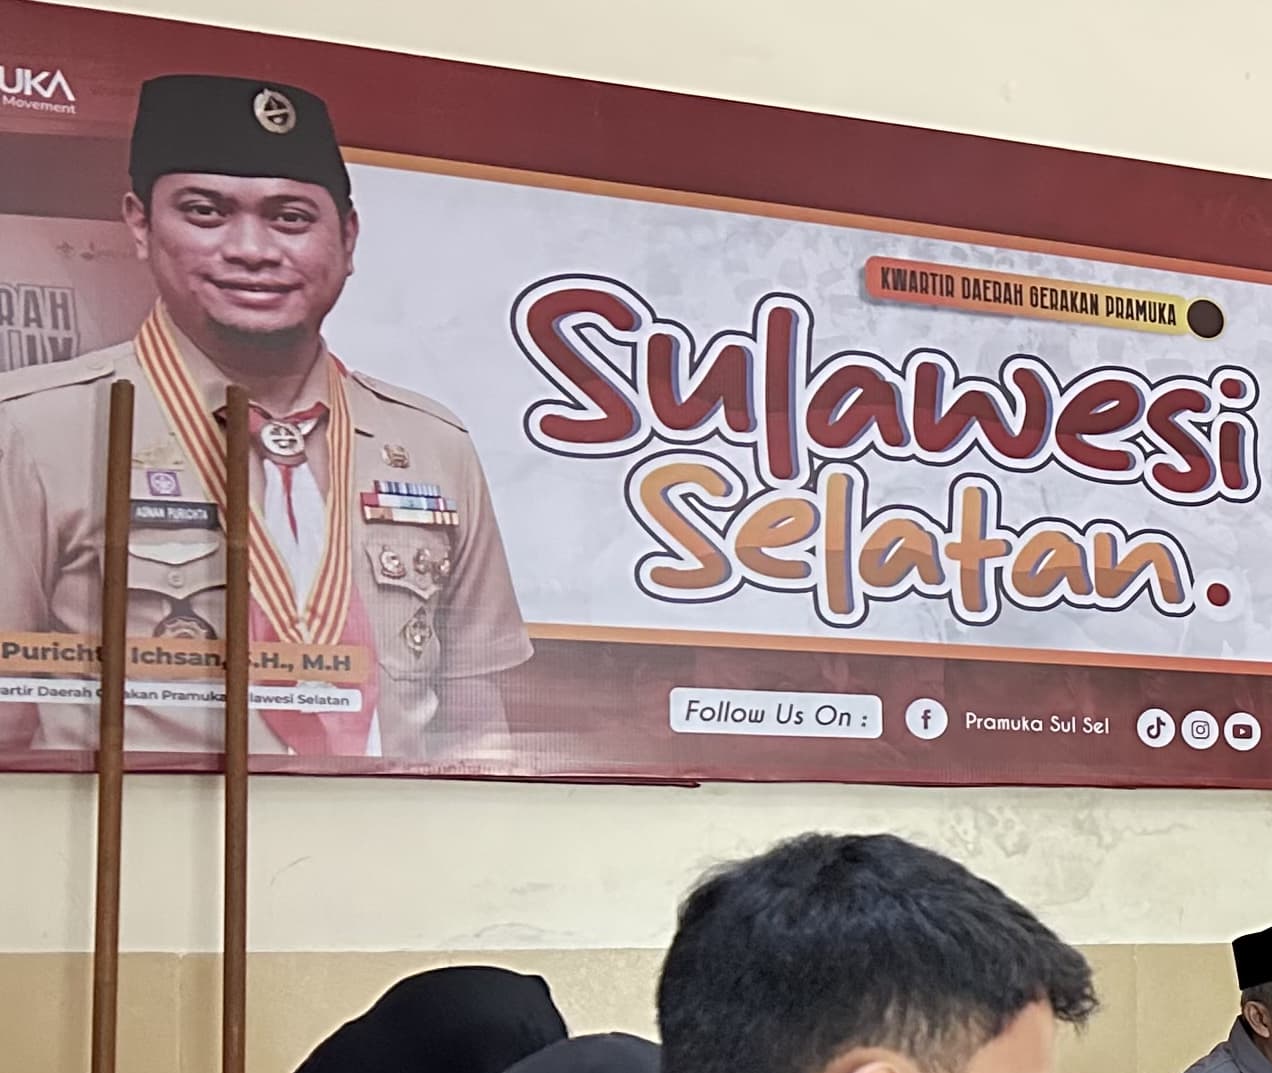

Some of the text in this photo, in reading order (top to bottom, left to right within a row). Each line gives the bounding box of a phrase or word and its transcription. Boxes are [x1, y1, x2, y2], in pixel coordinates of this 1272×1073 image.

[881, 266, 1177, 326] KWARTIR DAERAH GERAKAN PRAMUKA
[517, 280, 1255, 501] Sulawesi
[303, 654, 351, 671] M.H
[38, 686, 92, 698] Daerah
[163, 690, 228, 702] Pramuka
[298, 694, 350, 706] Selatan
[684, 700, 764, 723] Follow
[777, 703, 803, 725] Us
[815, 705, 851, 727] On
[966, 712, 1043, 732] Pramuka
[1050, 714, 1076, 733] Sul
[1083, 715, 1110, 734] Sel
